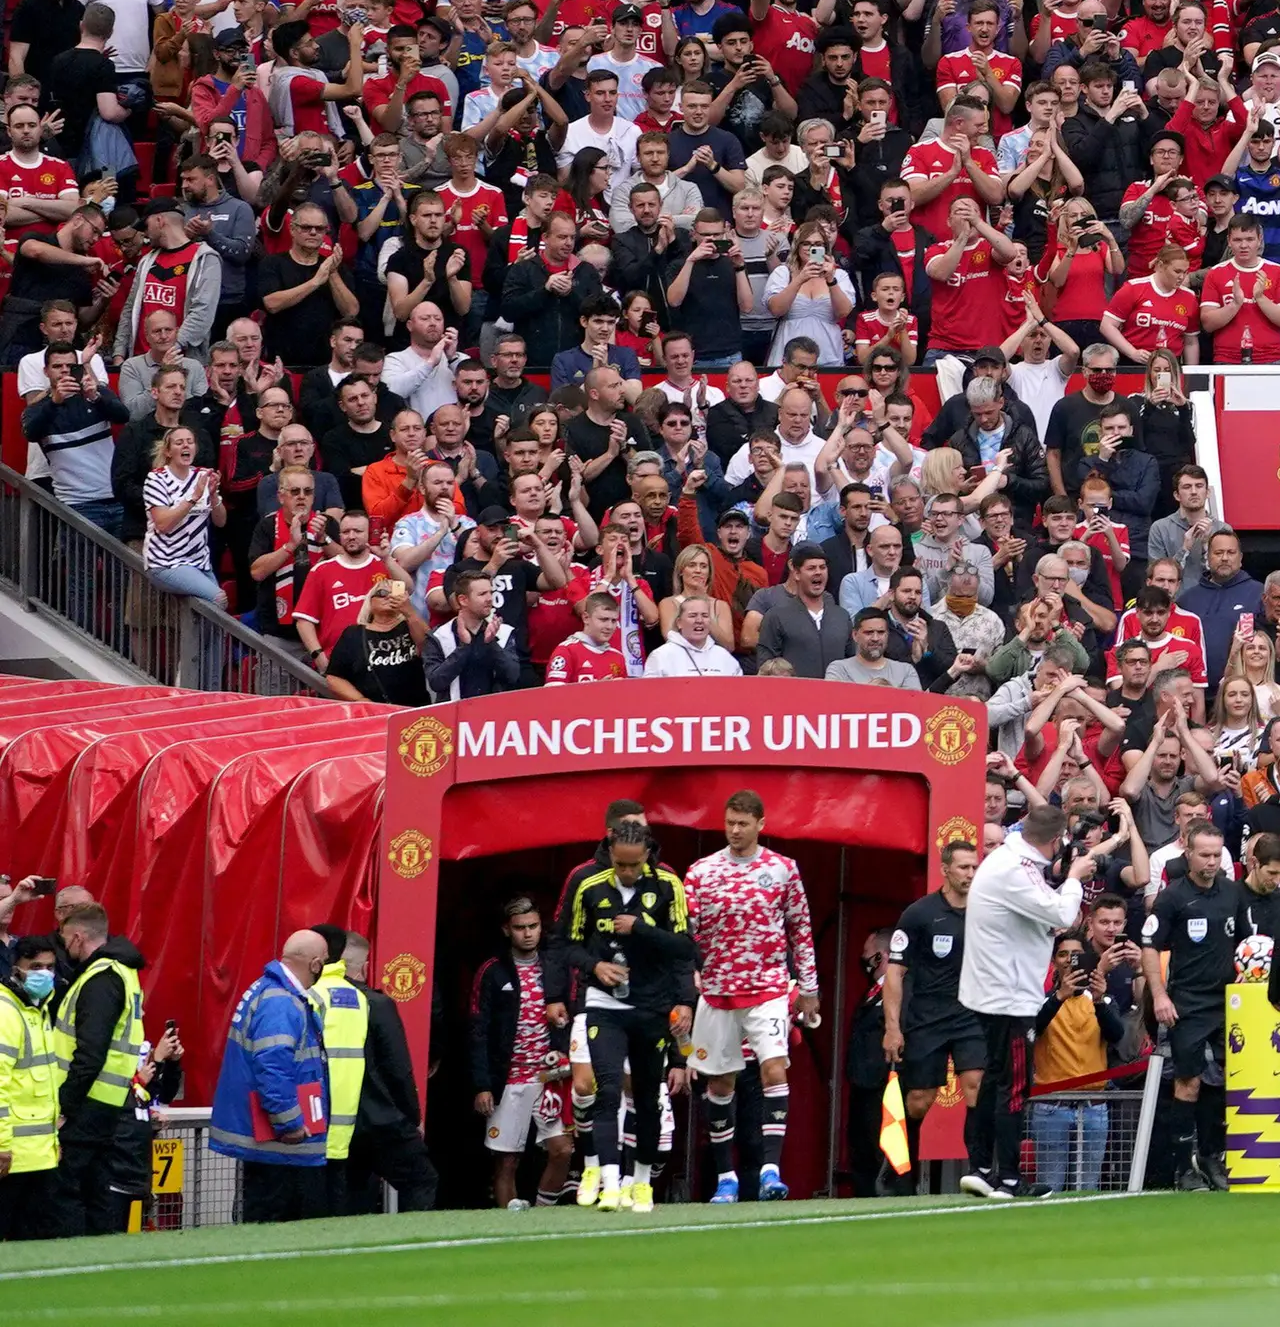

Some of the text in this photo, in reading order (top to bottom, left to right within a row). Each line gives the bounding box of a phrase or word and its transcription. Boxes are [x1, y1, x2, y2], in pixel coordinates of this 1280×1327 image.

[145, 284, 175, 304] AIG
[1150, 317, 1187, 330] TeamViewer
[492, 574, 513, 591] UST
[368, 634, 411, 652] LOVE
[403, 716, 451, 741] MANCHESTER
[458, 713, 922, 756] MANCHESTER UNITED
[935, 749, 967, 764] UNITED
[409, 761, 443, 777] UNITED
[769, 1017, 788, 1038] 31
[154, 1141, 177, 1154] WSP
